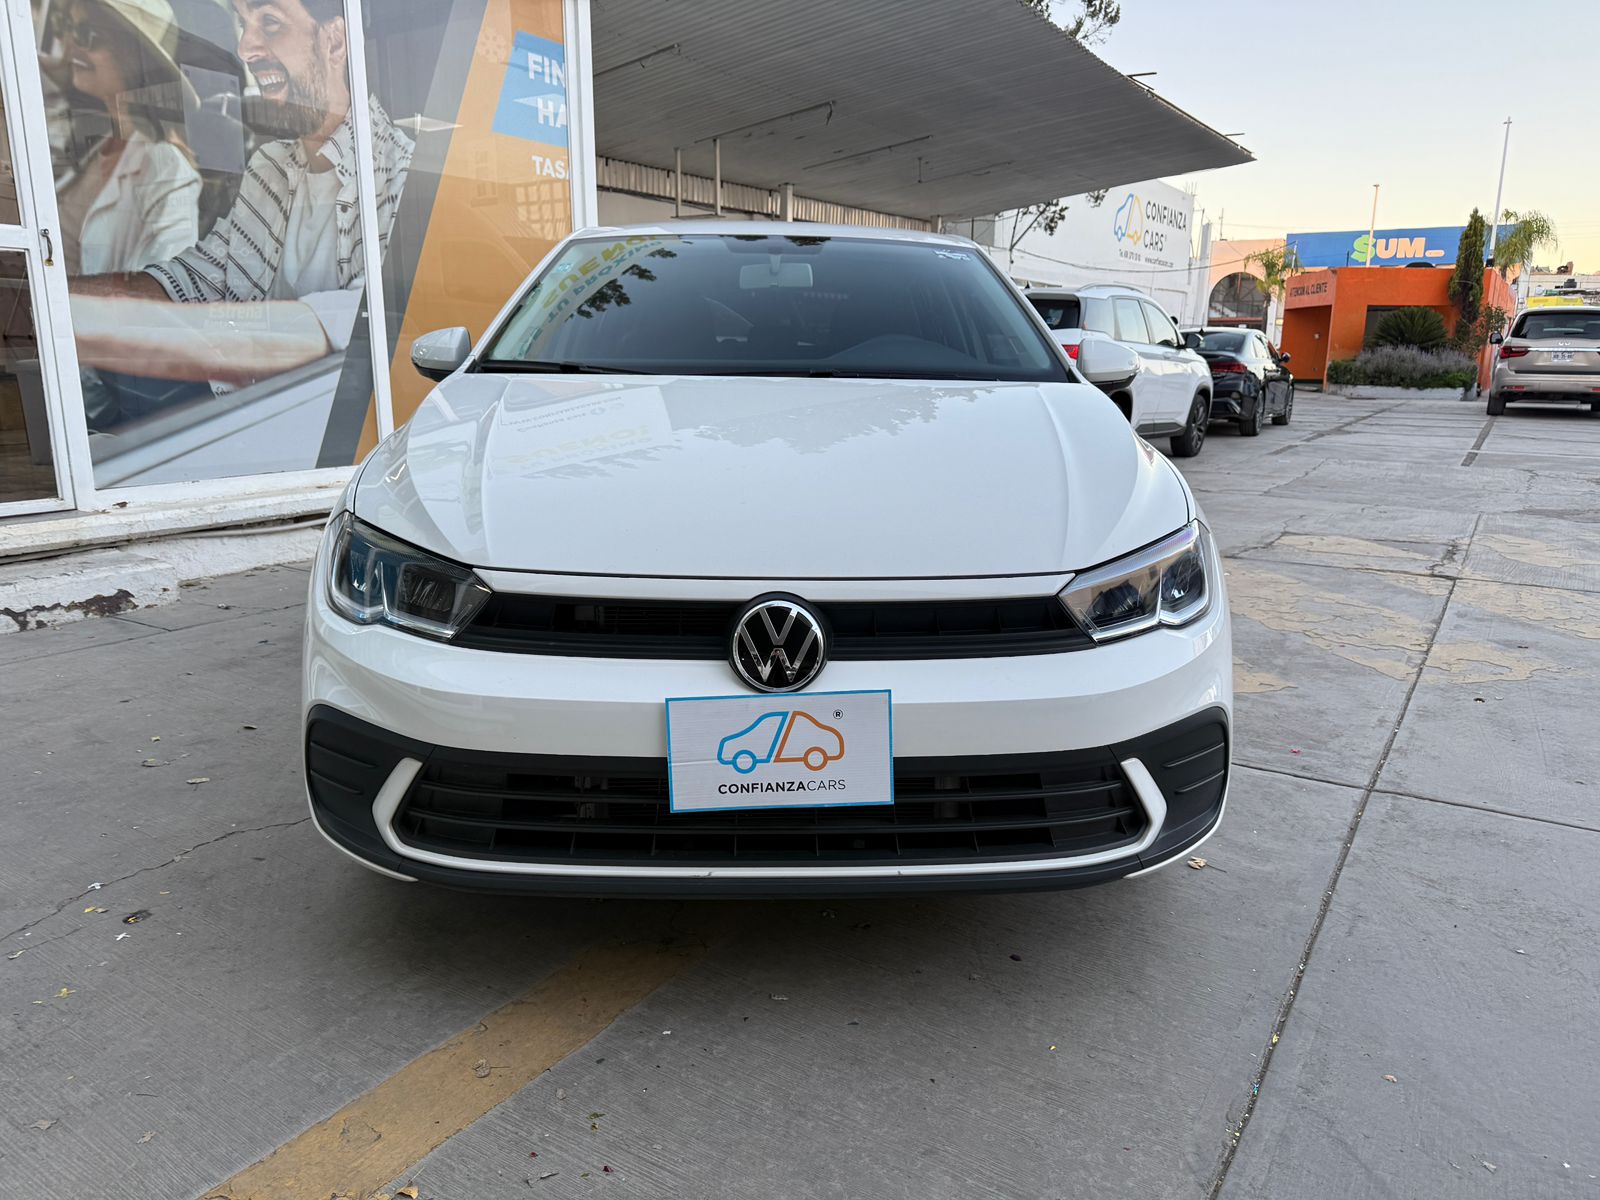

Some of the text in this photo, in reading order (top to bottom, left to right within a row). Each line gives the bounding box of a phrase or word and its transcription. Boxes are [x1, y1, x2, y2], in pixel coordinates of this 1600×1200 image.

[531, 155, 569, 180] TAS
[1145, 200, 1187, 232] CONFIANZA
[1143, 229, 1164, 252] CARS
[717, 779, 847, 795] CONFIANZACARS
